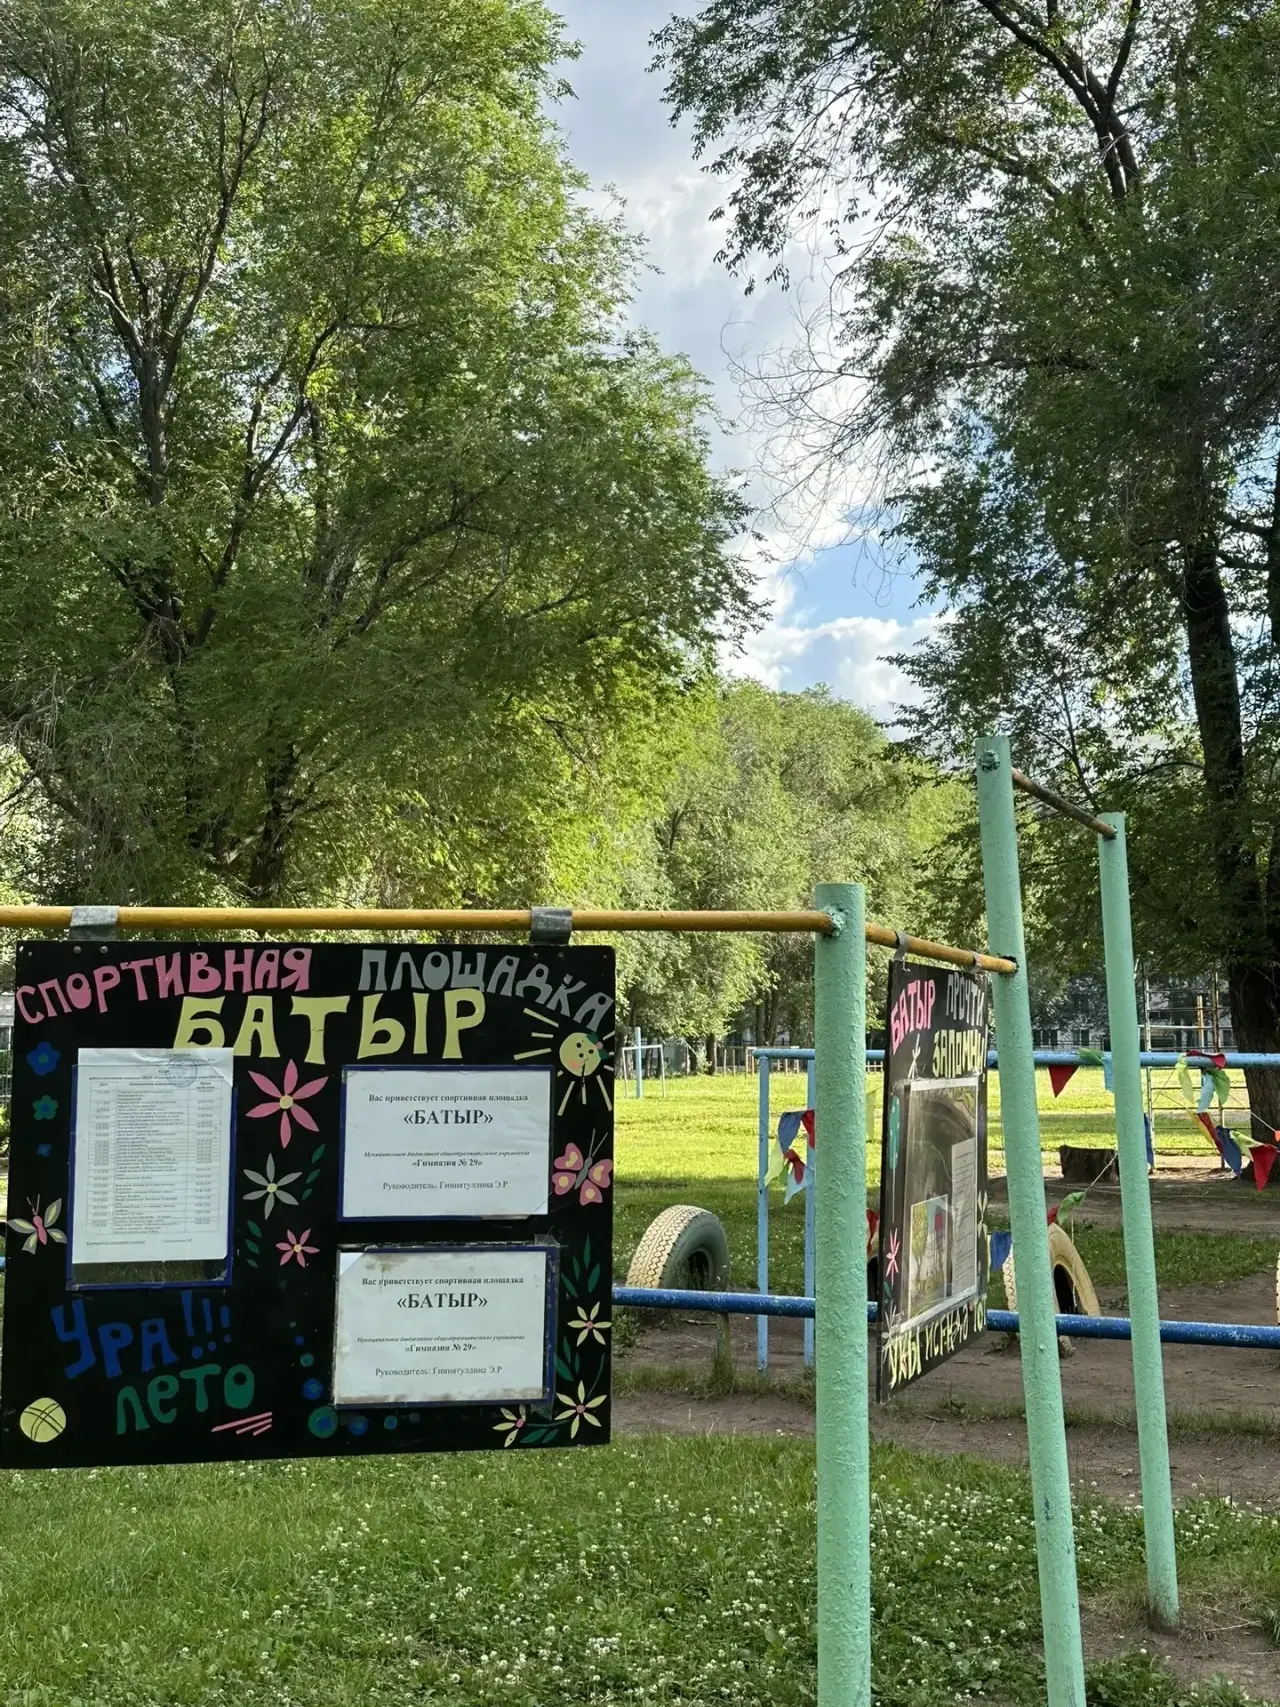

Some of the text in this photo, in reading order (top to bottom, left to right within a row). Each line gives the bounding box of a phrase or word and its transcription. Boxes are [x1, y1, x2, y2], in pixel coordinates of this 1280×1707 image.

[15, 948, 614, 1031] СПОРТИВНАЯ ПЛОЩАДКА
[891, 979, 935, 1055] БАТЫР
[173, 988, 485, 1064] БАТЫР
[368, 1094, 528, 1103] Вас приветствует спортивная площадка
[403, 1109, 493, 1125] «БАТЫР»
[383, 1182, 437, 1190] Руководитель:
[379, 1277, 432, 1286] приветствует
[434, 1277, 481, 1286] спортивная
[483, 1277, 524, 1285] площадка
[397, 1292, 488, 1309] «БАТЫР»
[375, 1367, 431, 1377] Руководитель:
